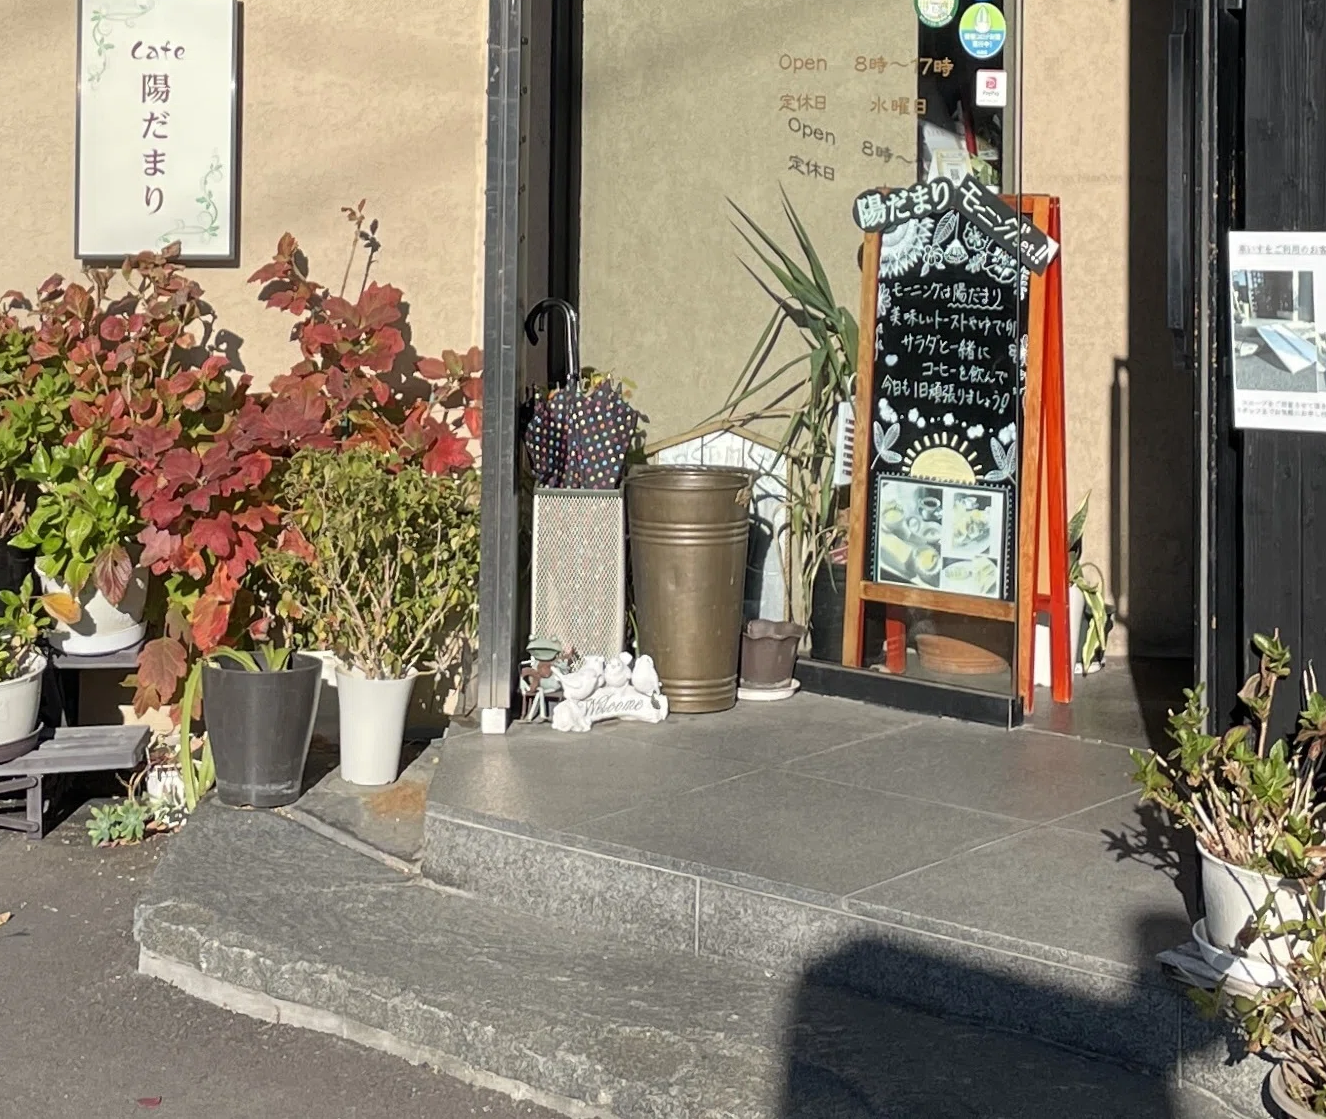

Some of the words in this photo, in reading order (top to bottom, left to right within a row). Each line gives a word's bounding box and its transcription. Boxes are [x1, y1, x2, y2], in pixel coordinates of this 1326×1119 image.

[779, 54, 827, 73] Open
[778, 94, 827, 112] 定休日
[870, 96, 927, 116] 水曜日
[141, 73, 171, 215] 陽だまり
[857, 181, 950, 229] 陽だまり
[922, 362, 1008, 385] コーヒーを飲んで
